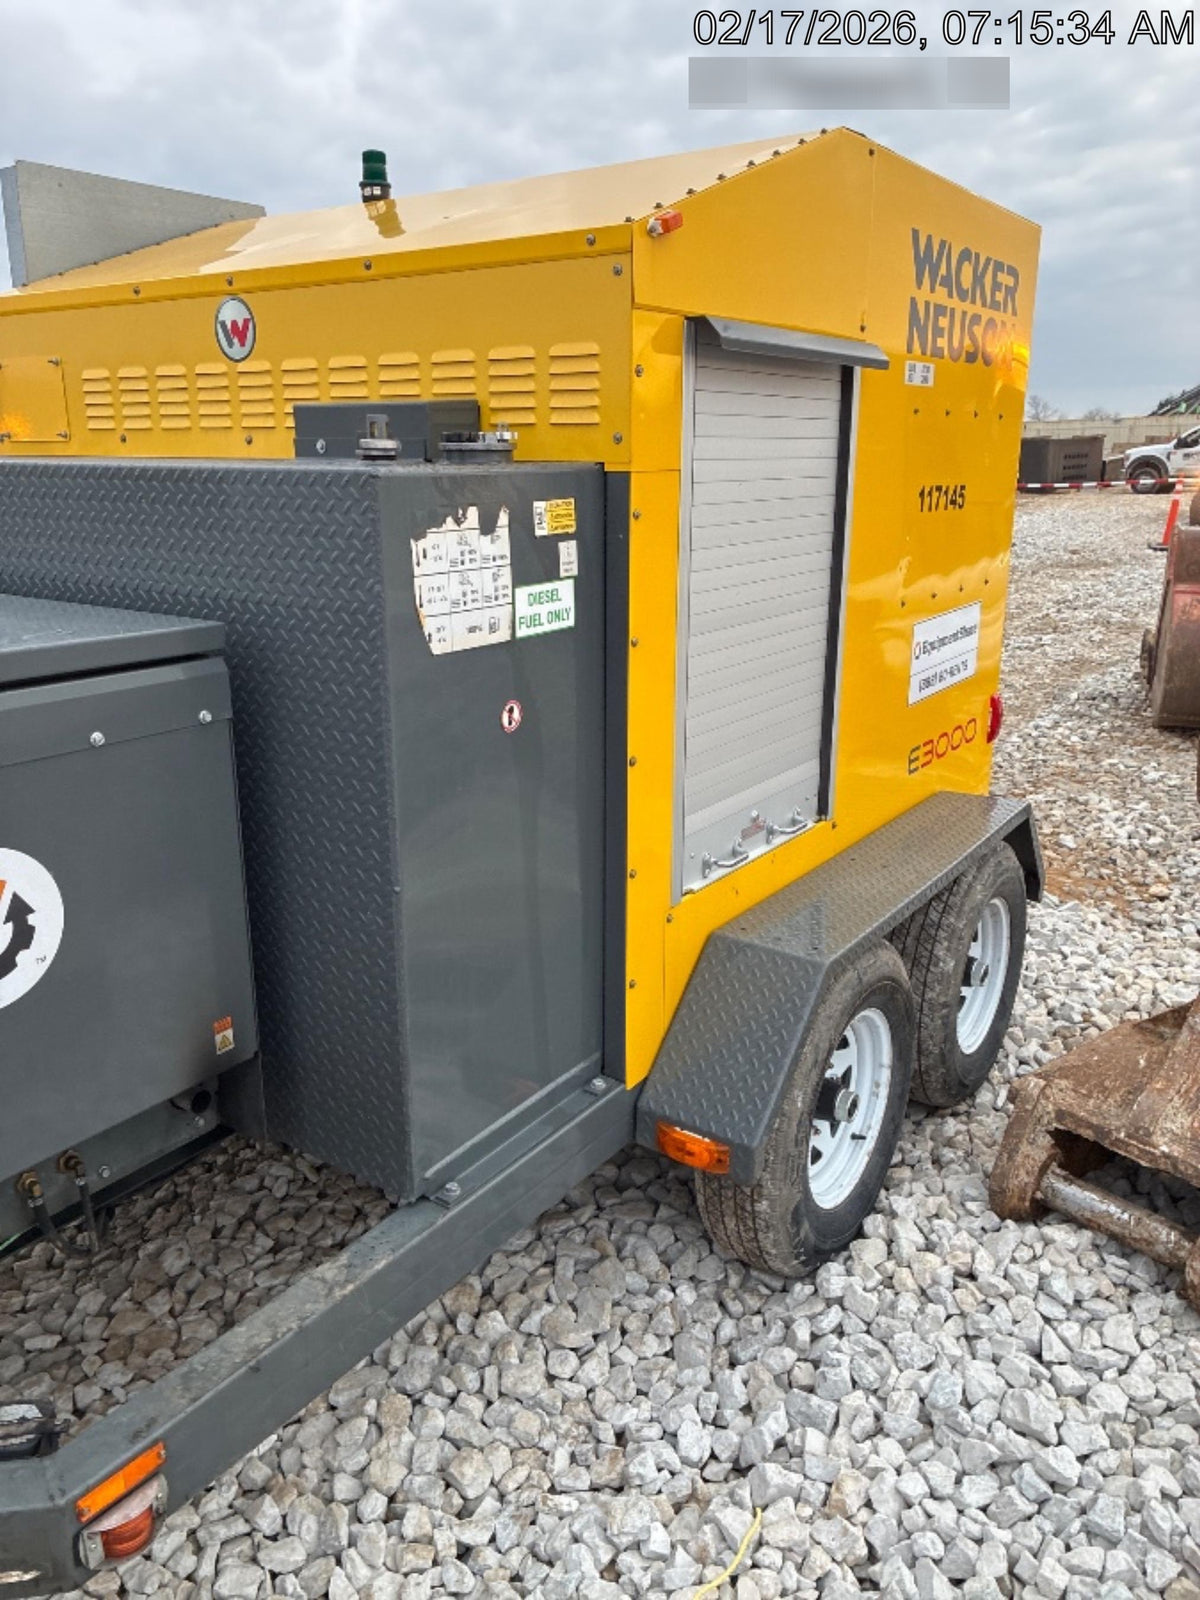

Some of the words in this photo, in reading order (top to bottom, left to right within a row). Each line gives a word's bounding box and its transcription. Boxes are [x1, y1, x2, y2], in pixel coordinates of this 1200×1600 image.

[911, 227, 1020, 317] WACKER
[918, 484, 966, 513] 117145
[527, 588, 562, 607] DIESEL
[518, 612, 544, 630] FUEL
[547, 606, 571, 624] ONLY
[907, 717, 977, 776] E3000
